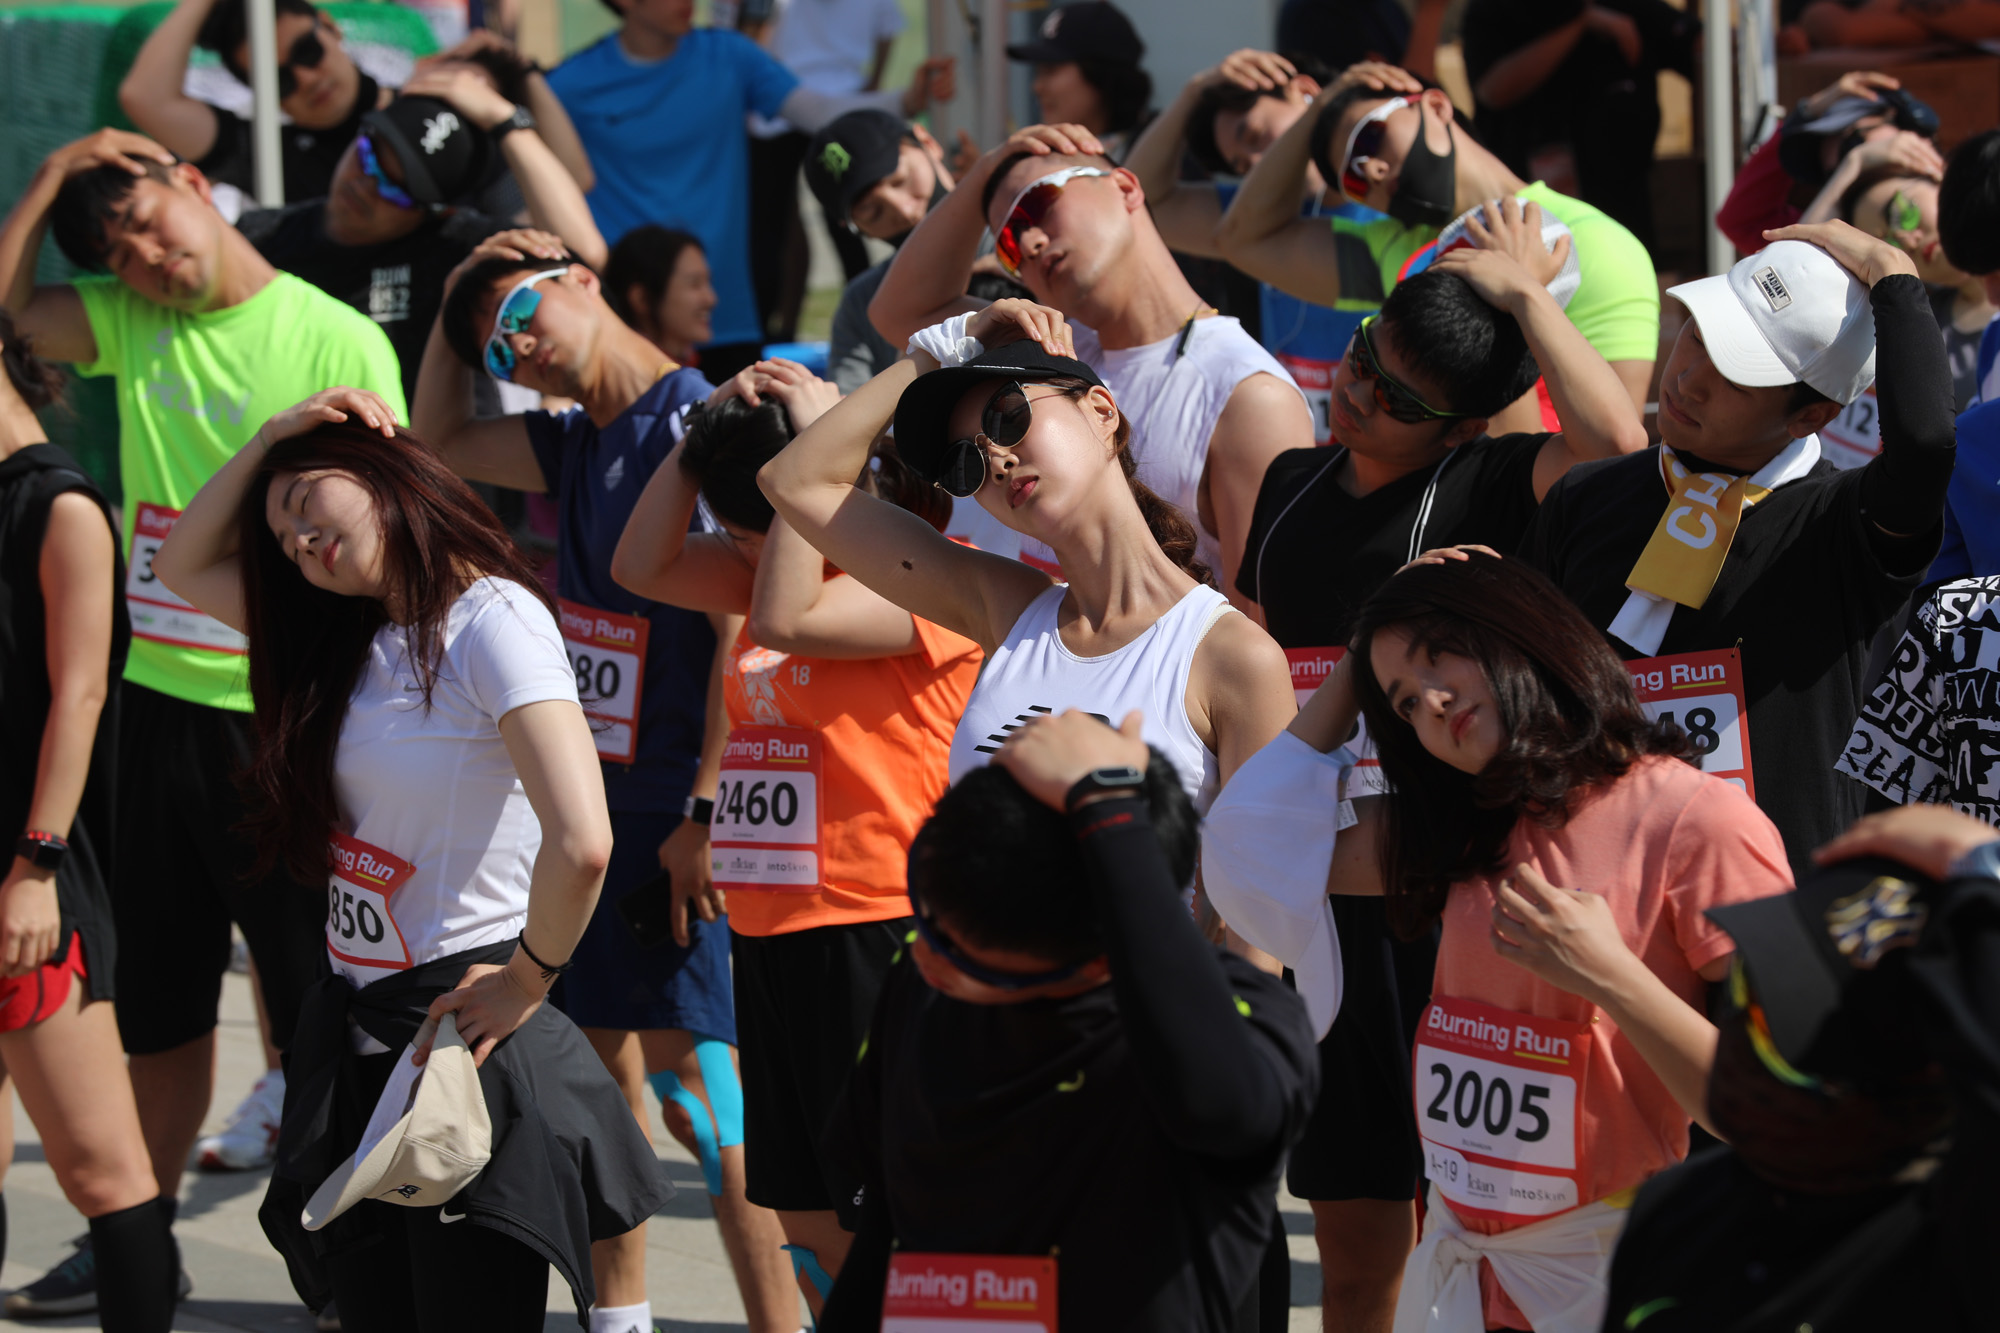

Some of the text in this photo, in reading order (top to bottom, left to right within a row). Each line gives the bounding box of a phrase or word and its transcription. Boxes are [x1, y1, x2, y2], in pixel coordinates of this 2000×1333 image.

[1765, 272, 1787, 299] RADIANT
[595, 618, 636, 643] Run
[568, 650, 621, 699] 80
[789, 665, 811, 686] 18
[1670, 663, 1726, 684] Run
[767, 739, 809, 758] Run
[715, 780, 798, 827] 2460
[356, 852, 395, 881] Run
[331, 884, 384, 944] 850
[1427, 1005, 1510, 1051] Burning
[1513, 1025, 1571, 1058] Run
[1427, 1062, 1551, 1143] 2005
[974, 1269, 1038, 1301] Run
